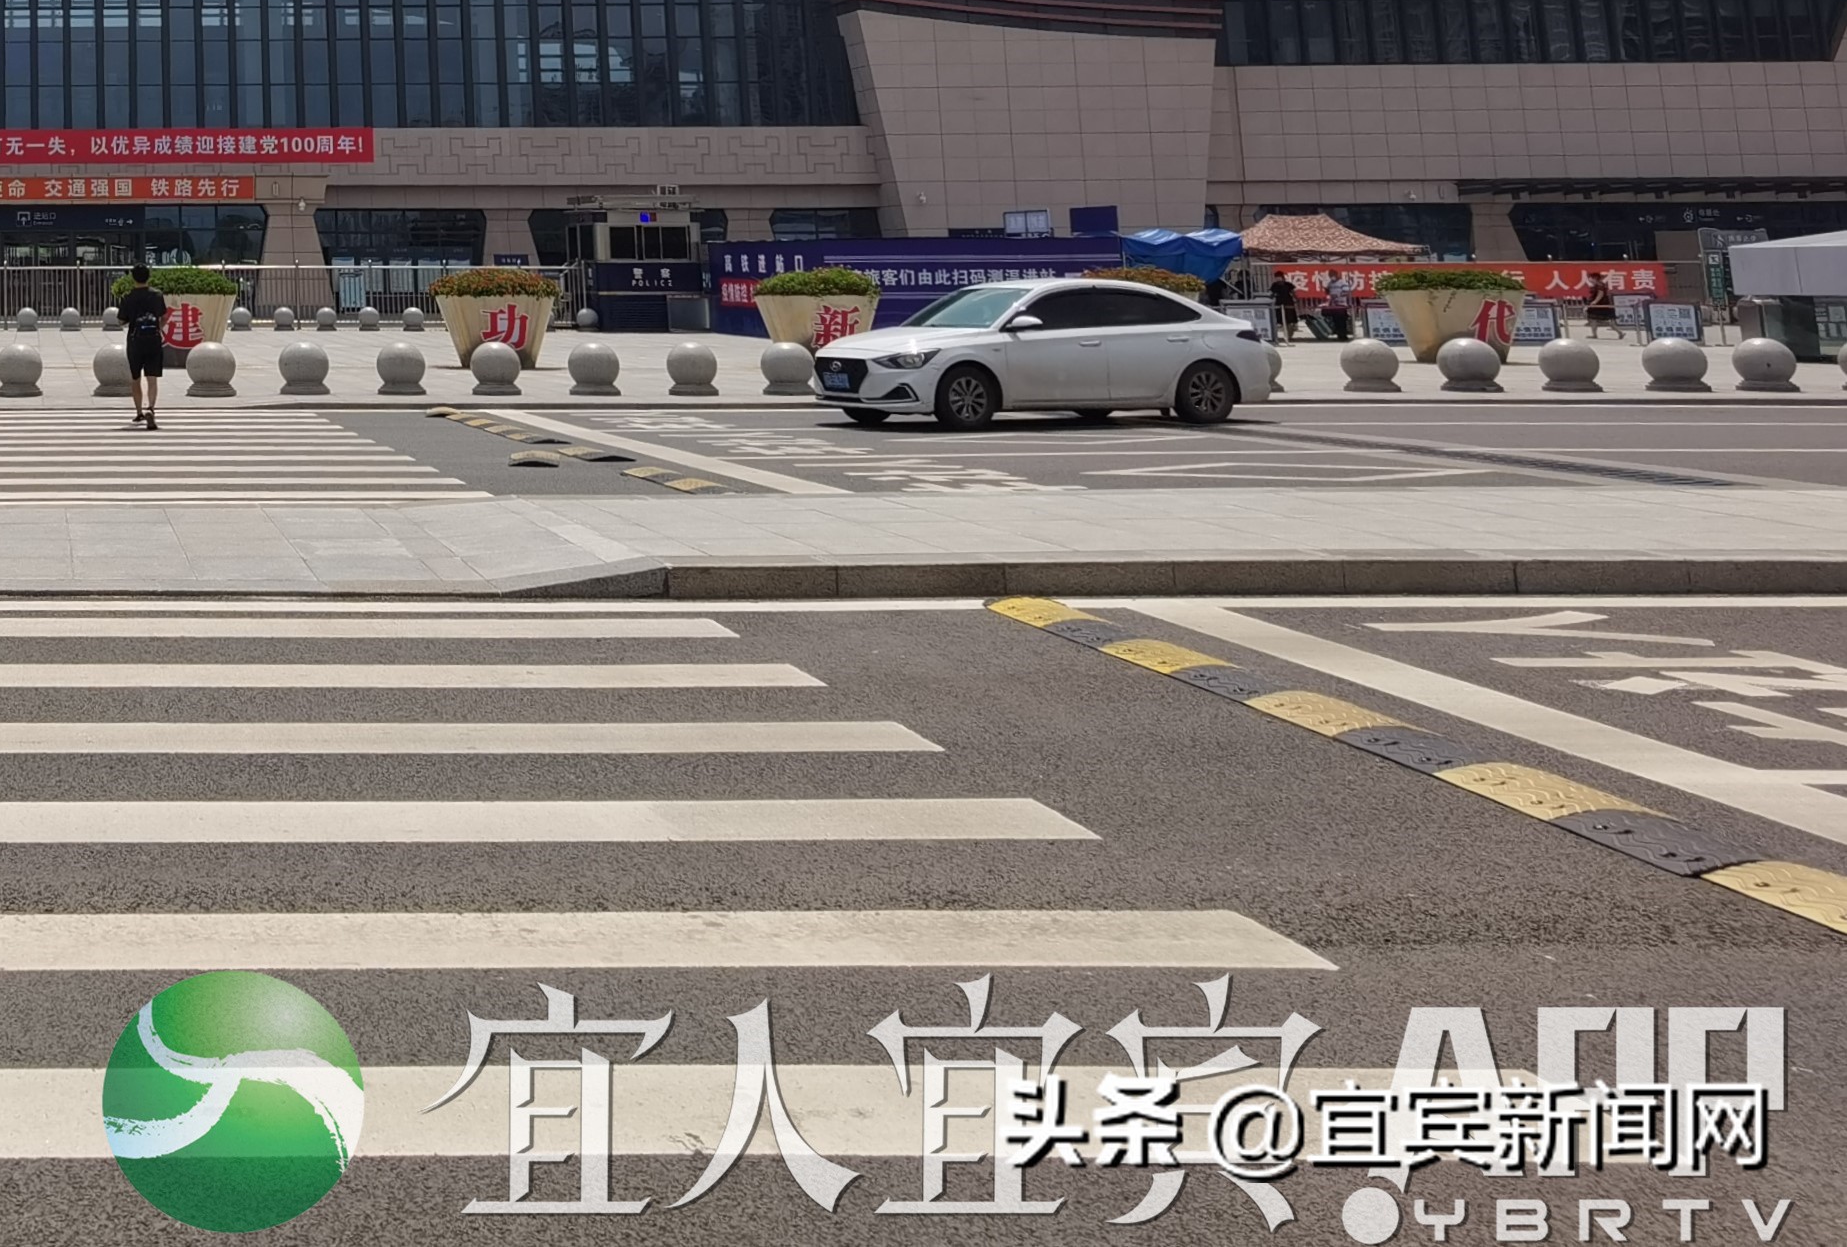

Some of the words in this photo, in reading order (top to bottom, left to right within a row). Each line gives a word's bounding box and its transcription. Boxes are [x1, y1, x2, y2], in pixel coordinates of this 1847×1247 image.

[44, 178, 133, 198] 交通强国
[150, 177, 240, 197] 铁路先行
[632, 268, 671, 279] 警察
[724, 254, 804, 273] 高铁进站口
[853, 268, 1056, 286] 旅客们由此扫码测温进站
[1545, 269, 1656, 290] 人人有责
[161, 302, 205, 349] 建
[481, 304, 529, 351] 功
[811, 305, 860, 348] 新
[1470, 298, 1517, 345] 代
